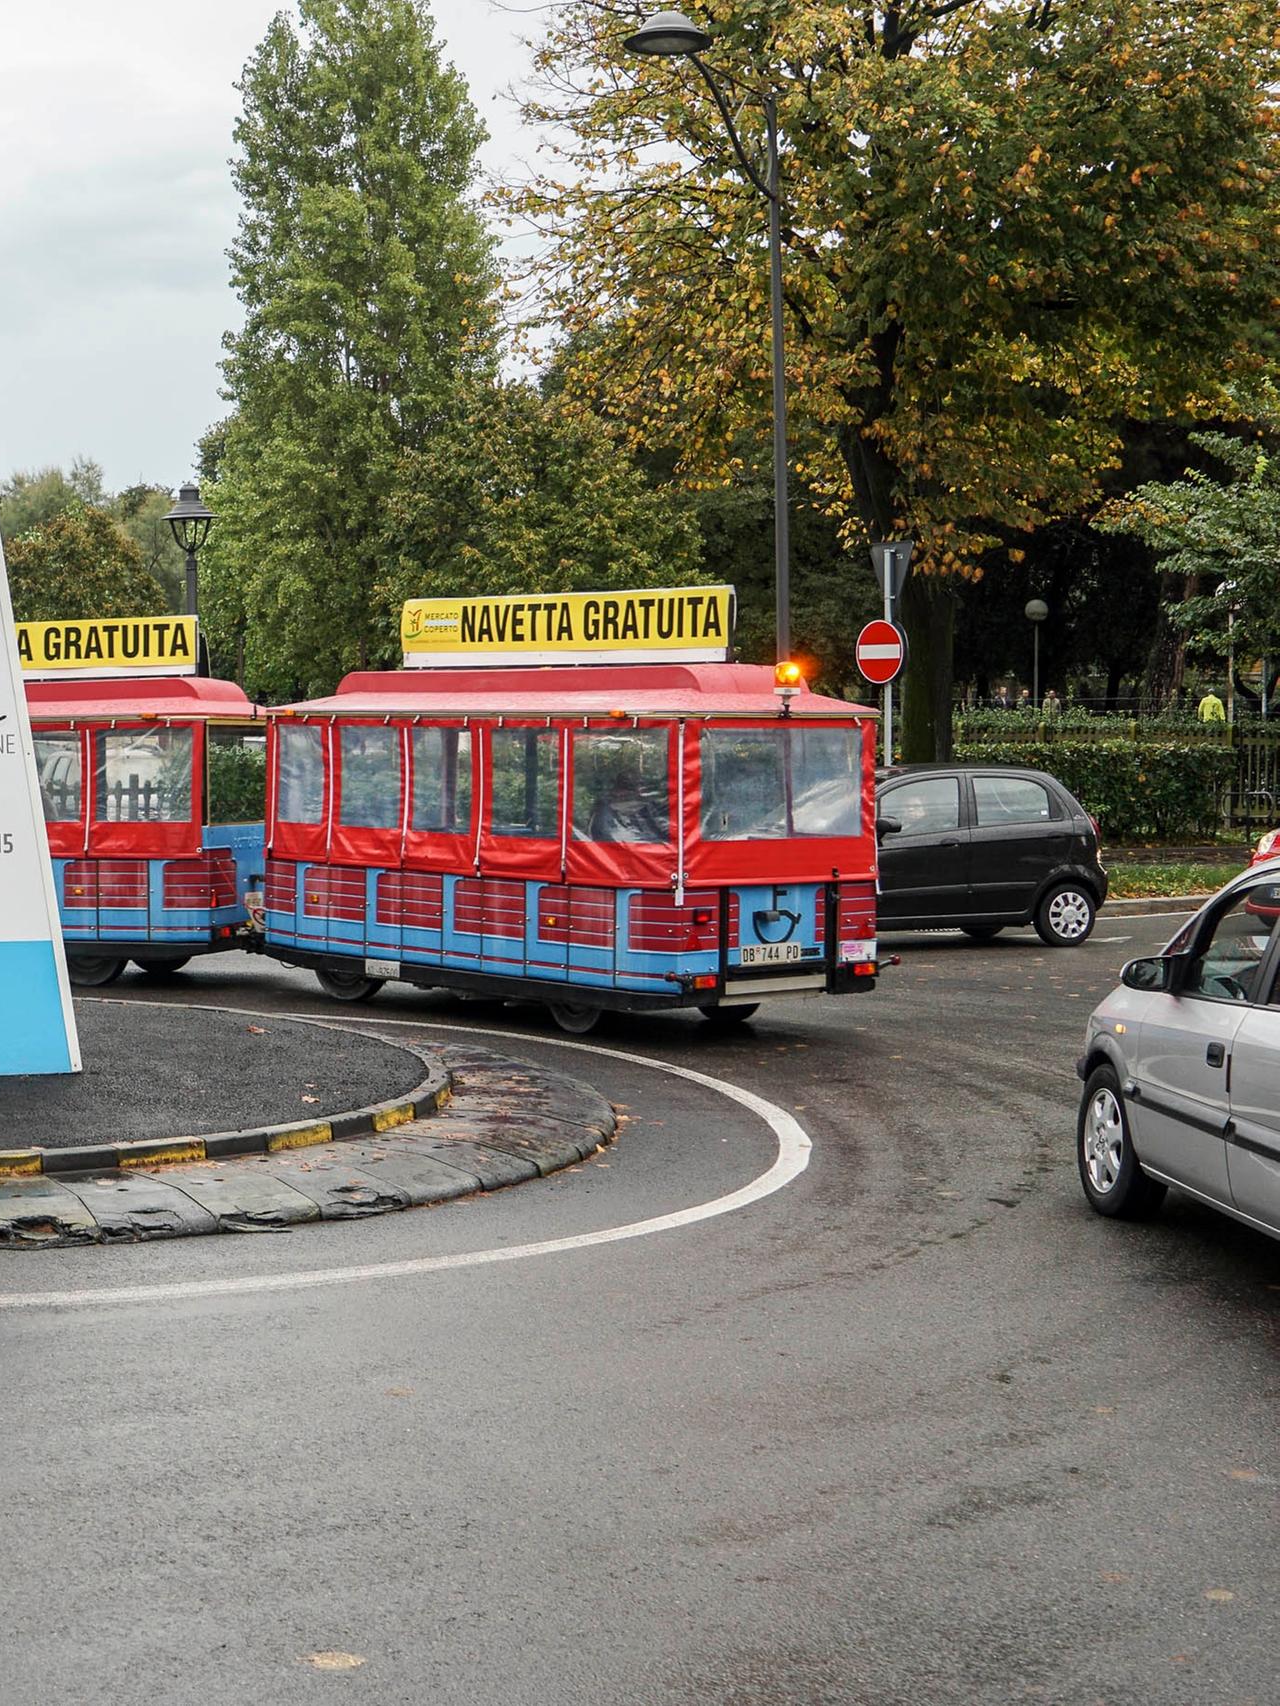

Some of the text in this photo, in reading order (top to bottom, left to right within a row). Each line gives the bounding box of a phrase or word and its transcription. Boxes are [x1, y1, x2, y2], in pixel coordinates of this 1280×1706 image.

[424, 612, 459, 621] MERCATO
[460, 596, 722, 643] NAVETTA GRATUITA
[424, 624, 458, 633] COPERTO
[43, 623, 190, 661] GRATUITA
[762, 945, 780, 961] 744
